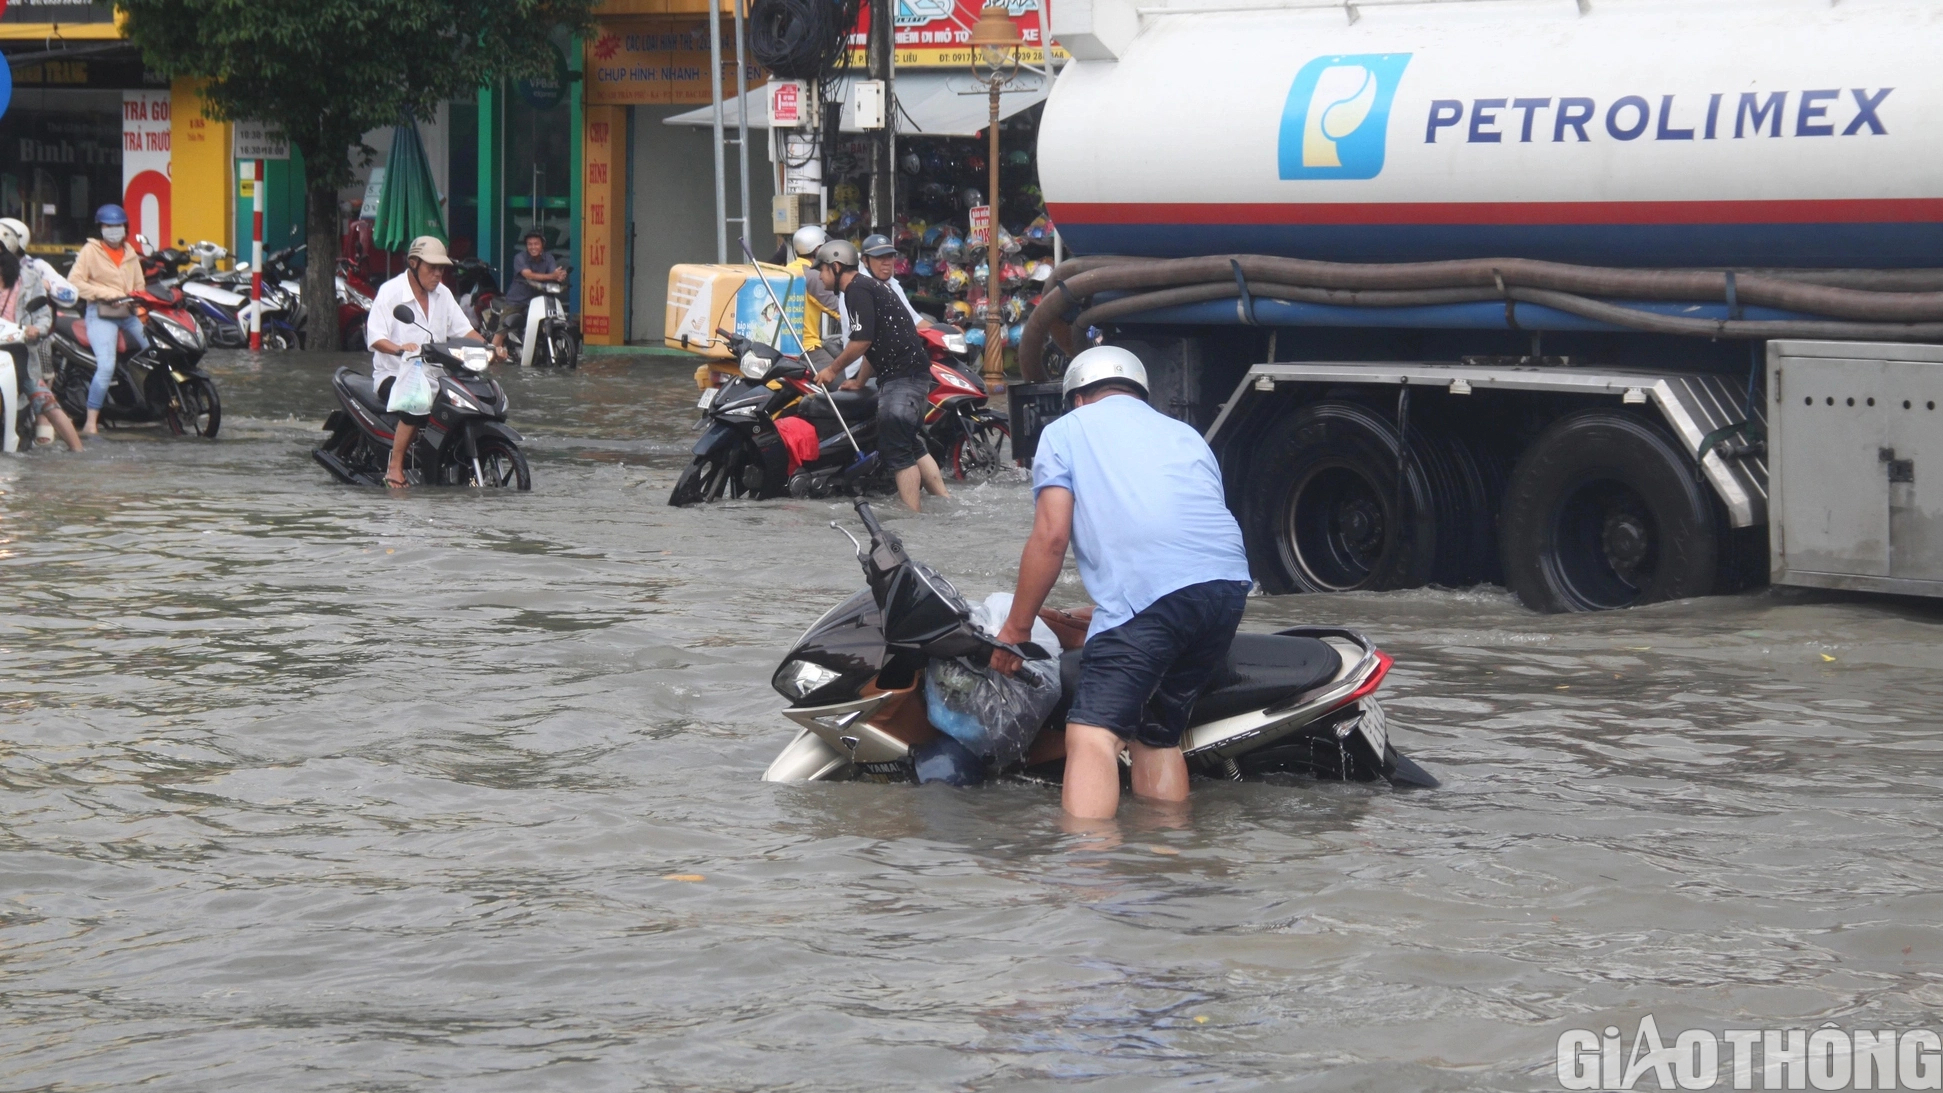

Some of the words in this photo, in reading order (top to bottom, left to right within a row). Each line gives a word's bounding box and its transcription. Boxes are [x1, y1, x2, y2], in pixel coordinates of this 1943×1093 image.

[921, 31, 933, 44] ĐI
[934, 28, 953, 44] MÔ
[1022, 29, 1040, 42] XE
[902, 53, 918, 63] LIÊU
[939, 52, 951, 63] ĐT:
[598, 67, 627, 84] CHỤP
[661, 67, 700, 81] NHANH
[123, 94, 147, 121] TRẢ
[1424, 88, 1896, 144] PETROLIMEX
[123, 125, 143, 151] TRẢ
[590, 123, 608, 148] CHỤP
[589, 159, 607, 184] HÌNH
[590, 195, 605, 225] THẺ
[590, 238, 606, 266] LẤY
[589, 279, 604, 306] GẤP
[866, 762, 900, 773] YAMA
